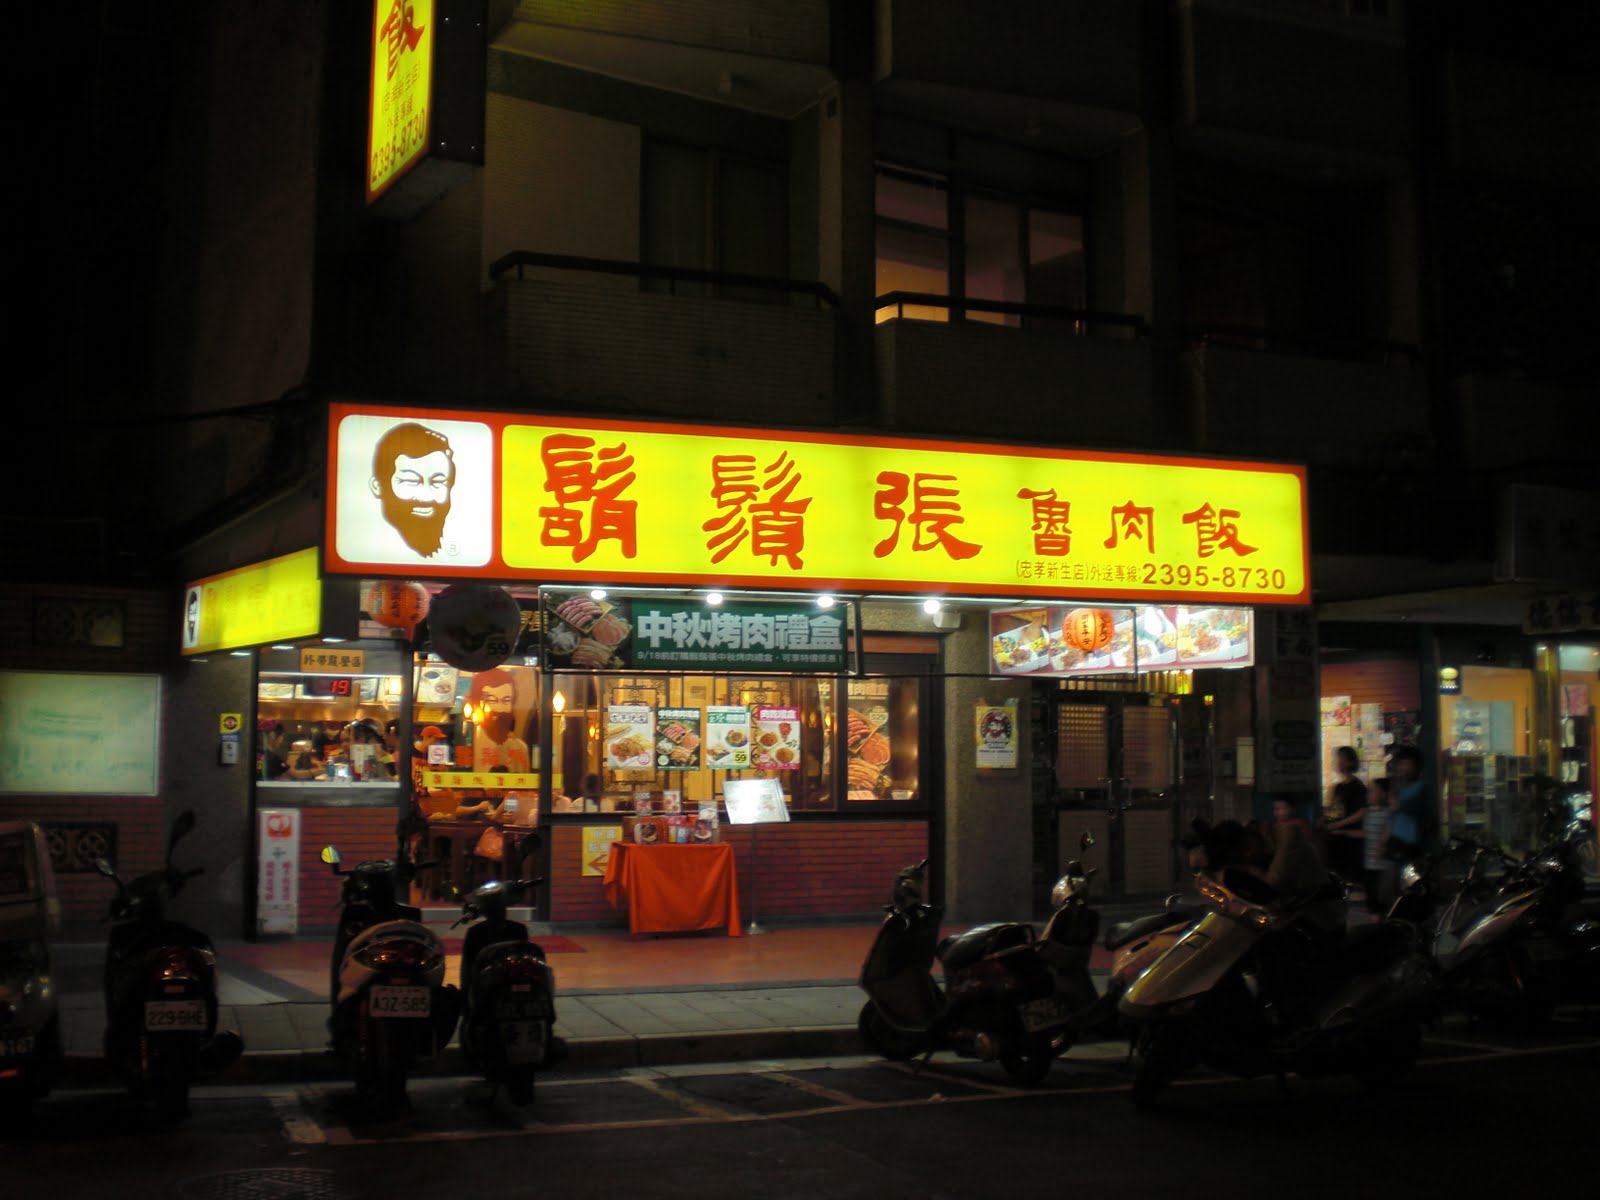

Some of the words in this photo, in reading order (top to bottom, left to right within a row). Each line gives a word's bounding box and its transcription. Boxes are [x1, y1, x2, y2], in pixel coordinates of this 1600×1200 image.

[371, 107, 426, 183] 2395-8730
[1142, 563, 1286, 590] 2395-8730
[637, 610, 843, 651] 中秋烤肉禮盒
[331, 679, 351, 695] 19
[733, 753, 747, 763] 59
